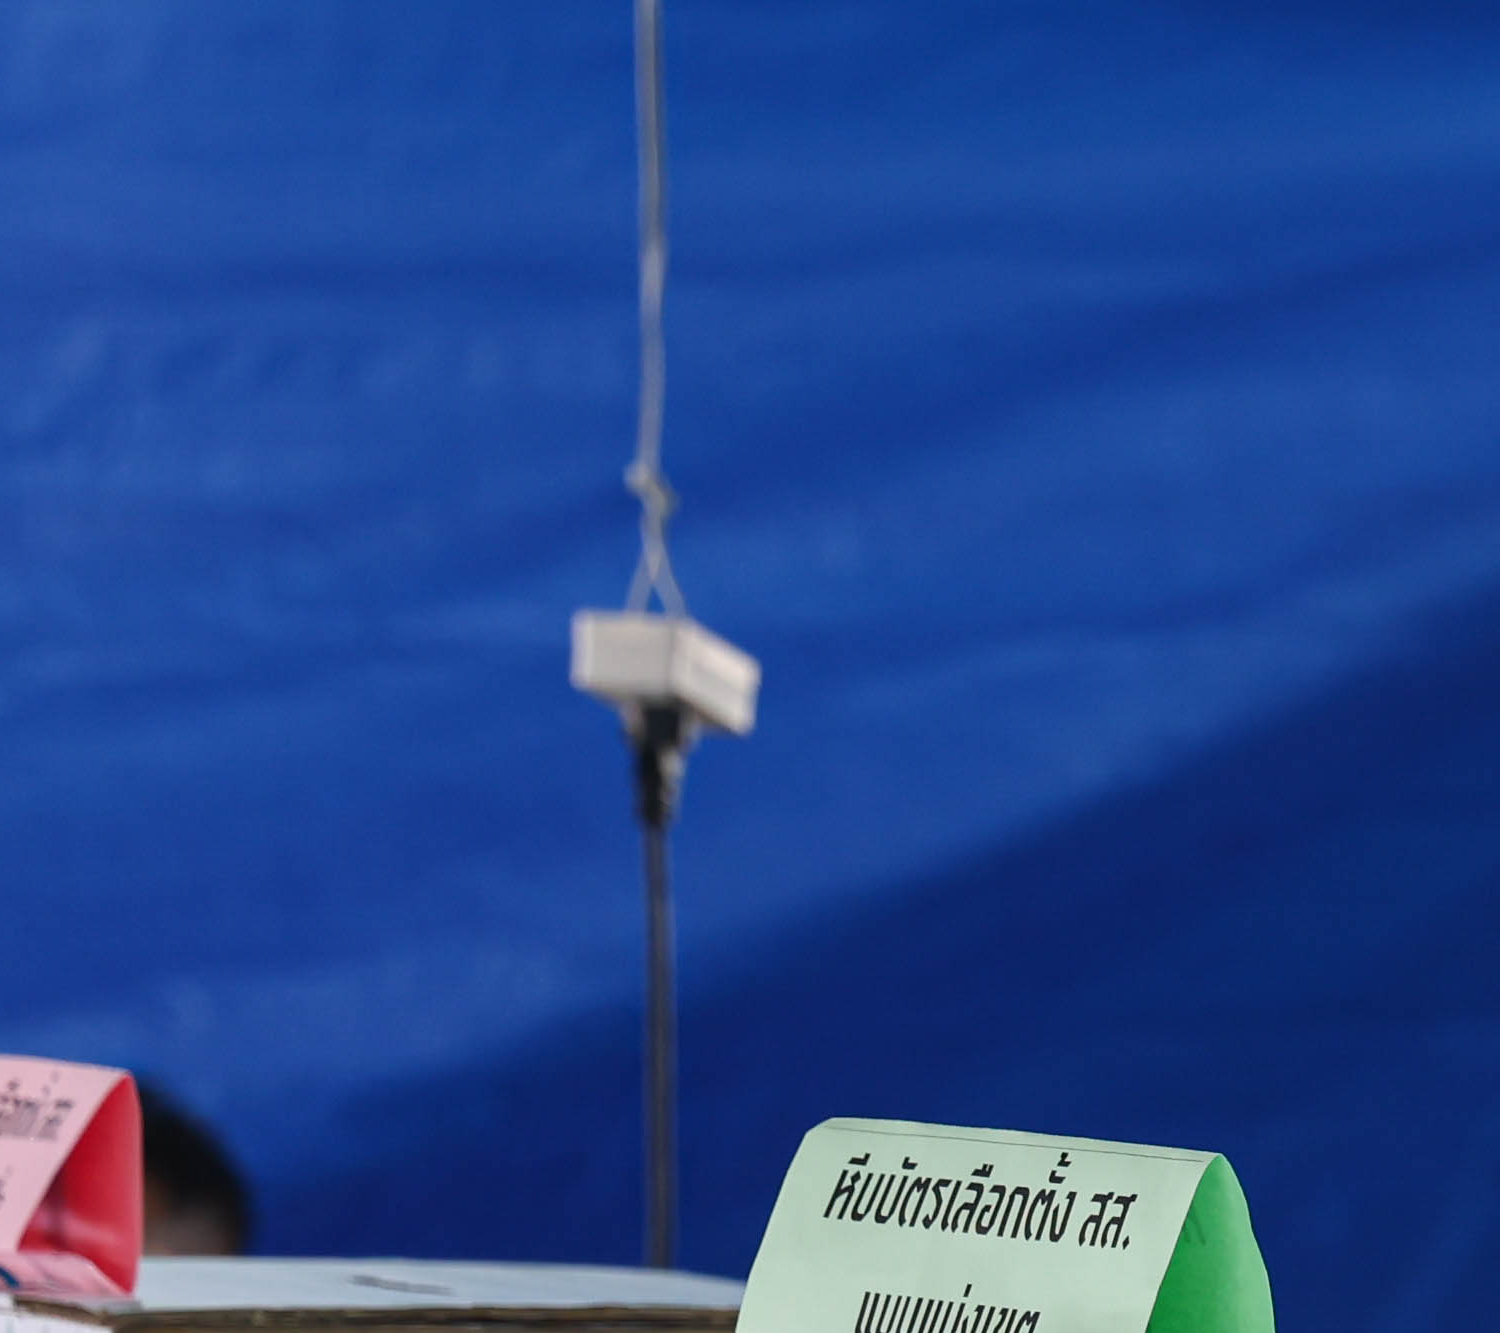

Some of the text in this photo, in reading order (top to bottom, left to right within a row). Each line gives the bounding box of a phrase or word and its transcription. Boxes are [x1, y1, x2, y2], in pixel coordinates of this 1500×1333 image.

[822, 1151, 1138, 1250] หีบบัตรเลือกตั้ง สส.
